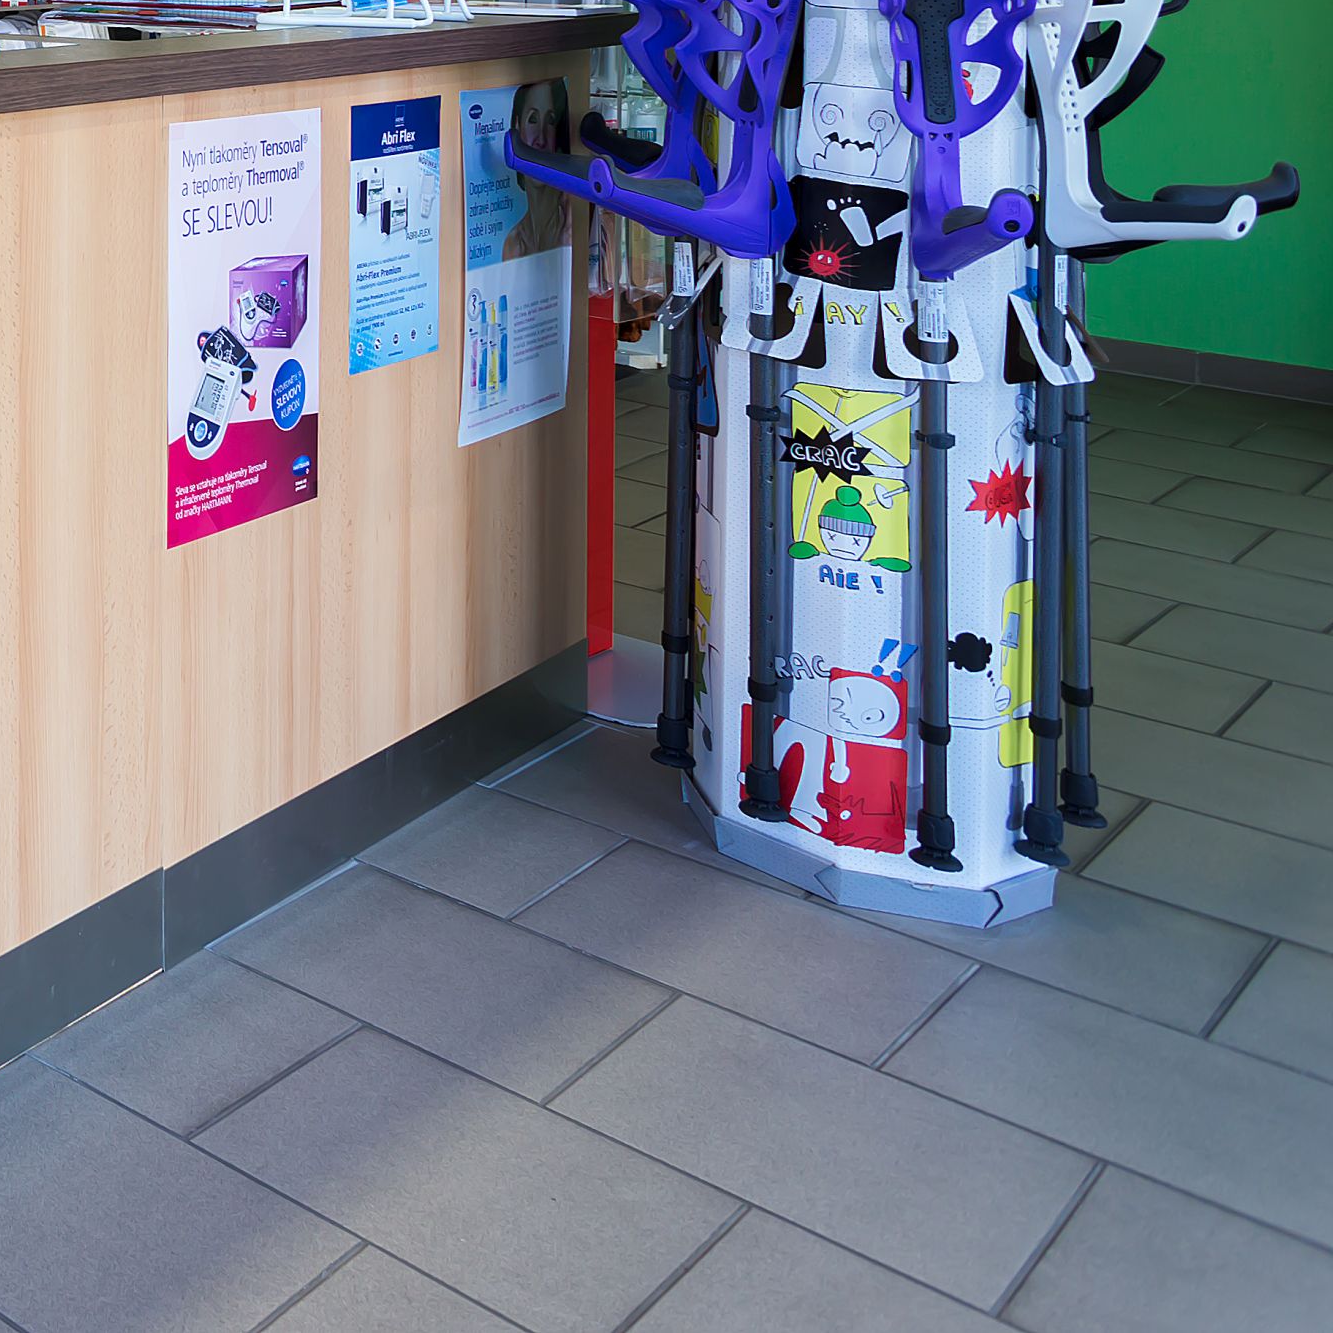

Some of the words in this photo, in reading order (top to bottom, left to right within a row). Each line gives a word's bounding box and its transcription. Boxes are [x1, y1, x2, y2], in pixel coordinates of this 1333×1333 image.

[381, 131, 398, 146] Abri
[400, 130, 415, 143] Flex
[182, 147, 206, 172] Nyní
[209, 142, 257, 164] tlakoměry
[182, 182, 188, 196] a
[193, 172, 243, 198] teploměry
[469, 178, 495, 196] Dopřejte
[495, 177, 511, 192] pocit
[183, 208, 200, 237] SE
[207, 196, 272, 233] SLEVOU!
[469, 205, 489, 217] zdravé
[490, 198, 514, 215] pokožky
[469, 222, 483, 238] sobě
[485, 224, 487, 234] i
[488, 220, 503, 235] svým
[469, 243, 492, 260] blízkým
[356, 271, 379, 282] Abri-Flex
[381, 266, 401, 277] Premium
[825, 302, 867, 325] AY
[276, 382, 302, 408] SLEVOVÝ
[281, 398, 300, 418] KUPON
[790, 442, 862, 472] CRAC
[175, 483, 188, 496] Sleva
[189, 483, 196, 492] se
[196, 476, 217, 490] vztahuje
[225, 468, 247, 481] tlakoměry
[248, 460, 267, 474] Tensoval
[175, 500, 179, 508] a
[180, 491, 210, 507] infračervené
[211, 482, 235, 497] teploměry
[235, 475, 259, 489] Thermoval
[175, 511, 182, 520] od
[184, 505, 200, 517] značky
